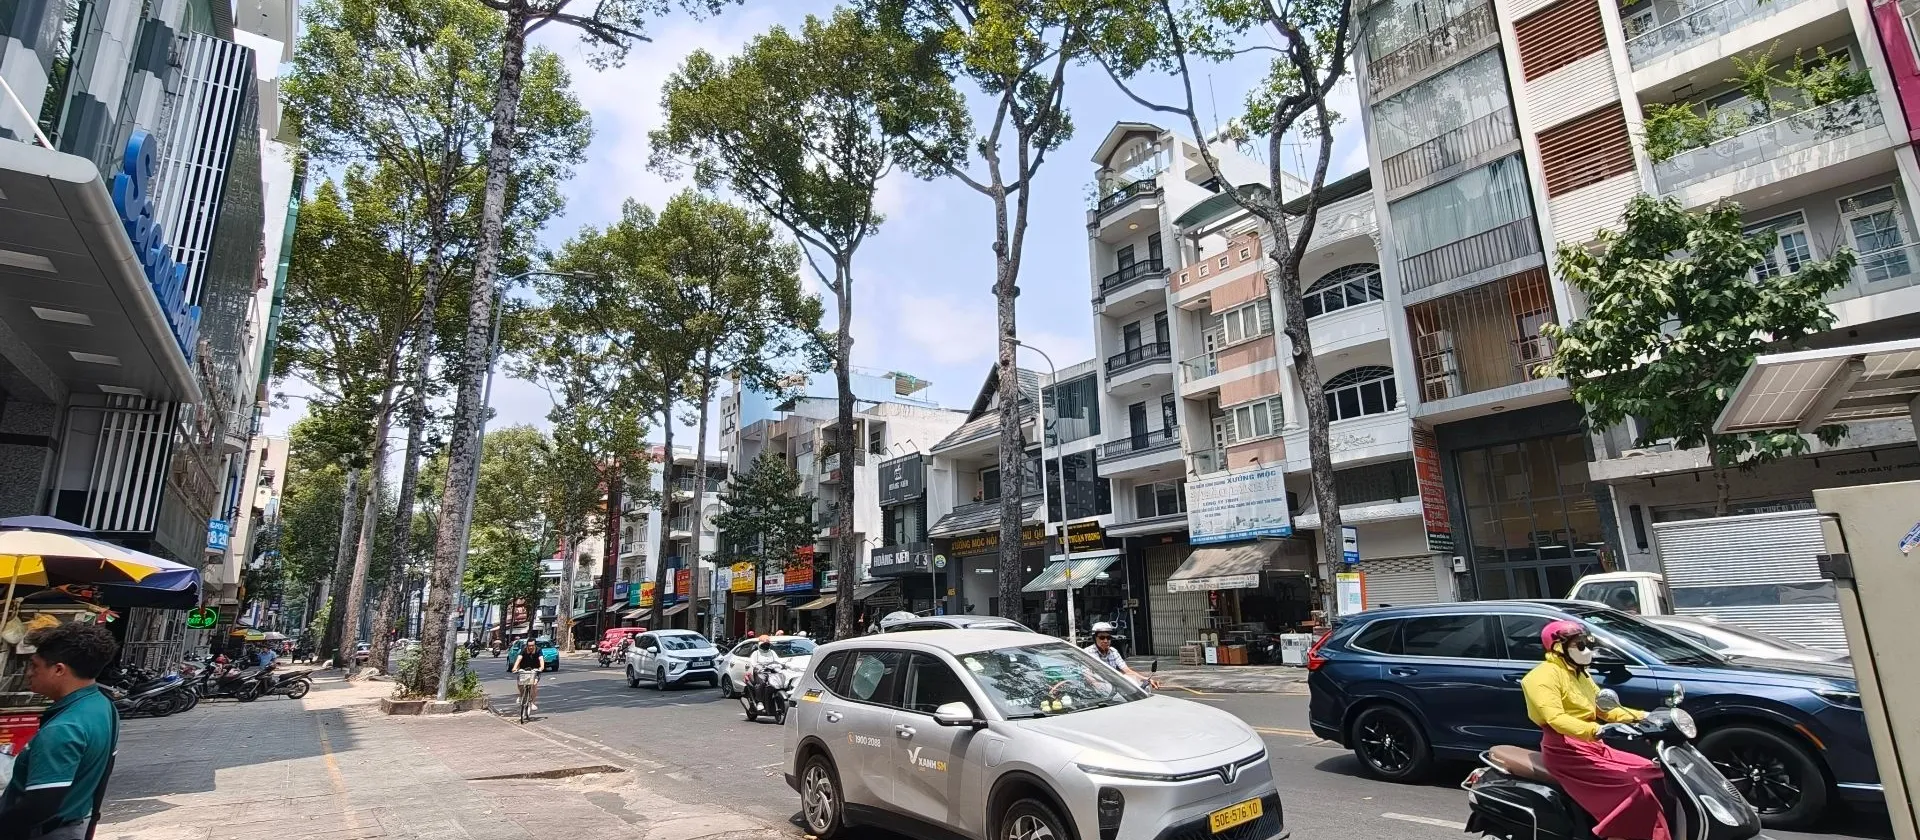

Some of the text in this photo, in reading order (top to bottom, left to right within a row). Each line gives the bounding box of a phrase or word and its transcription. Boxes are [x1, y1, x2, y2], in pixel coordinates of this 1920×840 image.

[855, 734, 881, 748] 1900 2088
[918, 757, 936, 770] XANH
